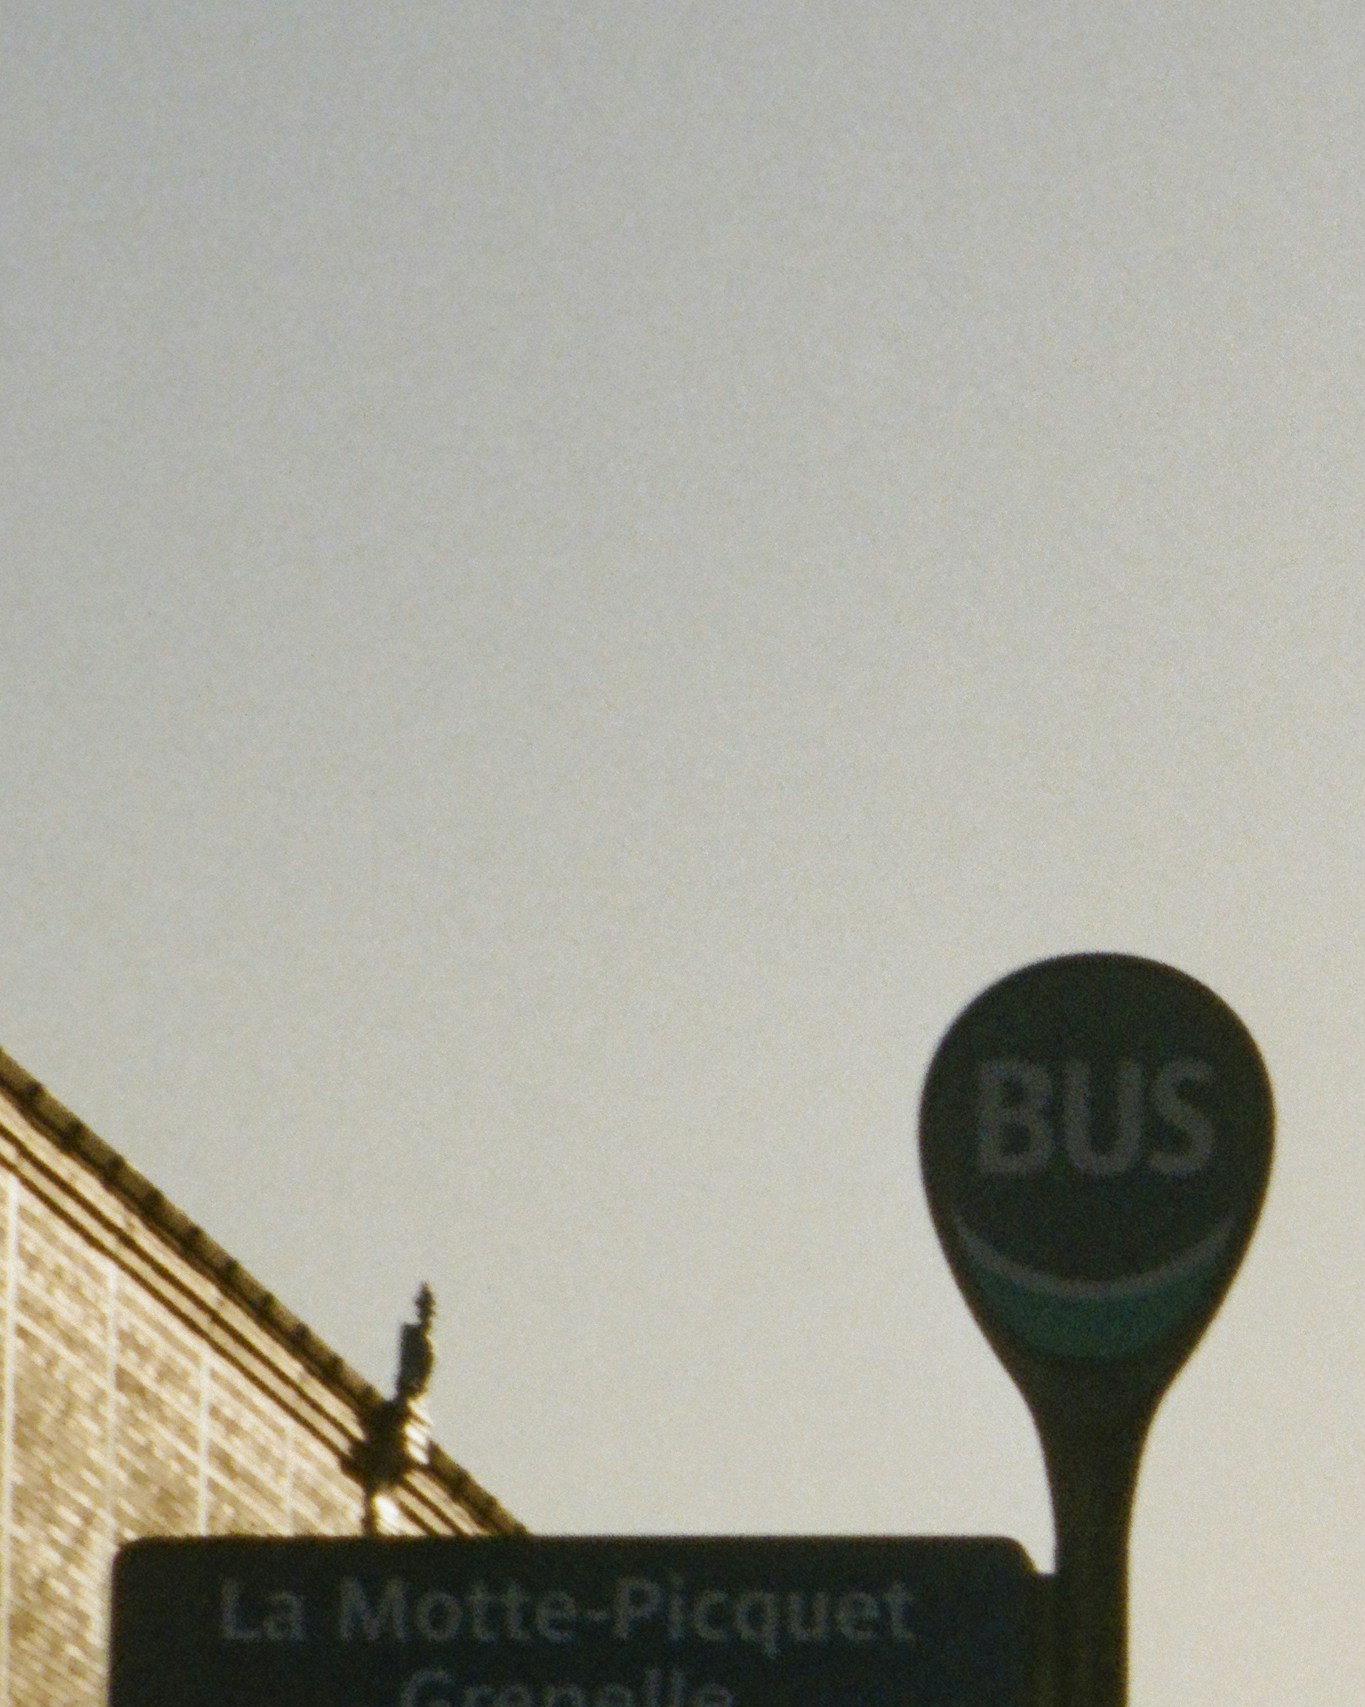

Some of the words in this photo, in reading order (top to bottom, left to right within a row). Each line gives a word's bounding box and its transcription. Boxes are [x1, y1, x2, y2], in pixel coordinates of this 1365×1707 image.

[977, 1058, 1216, 1176] BUS
[220, 1577, 307, 1642] La
[338, 1575, 917, 1658] Motte-Picquet
